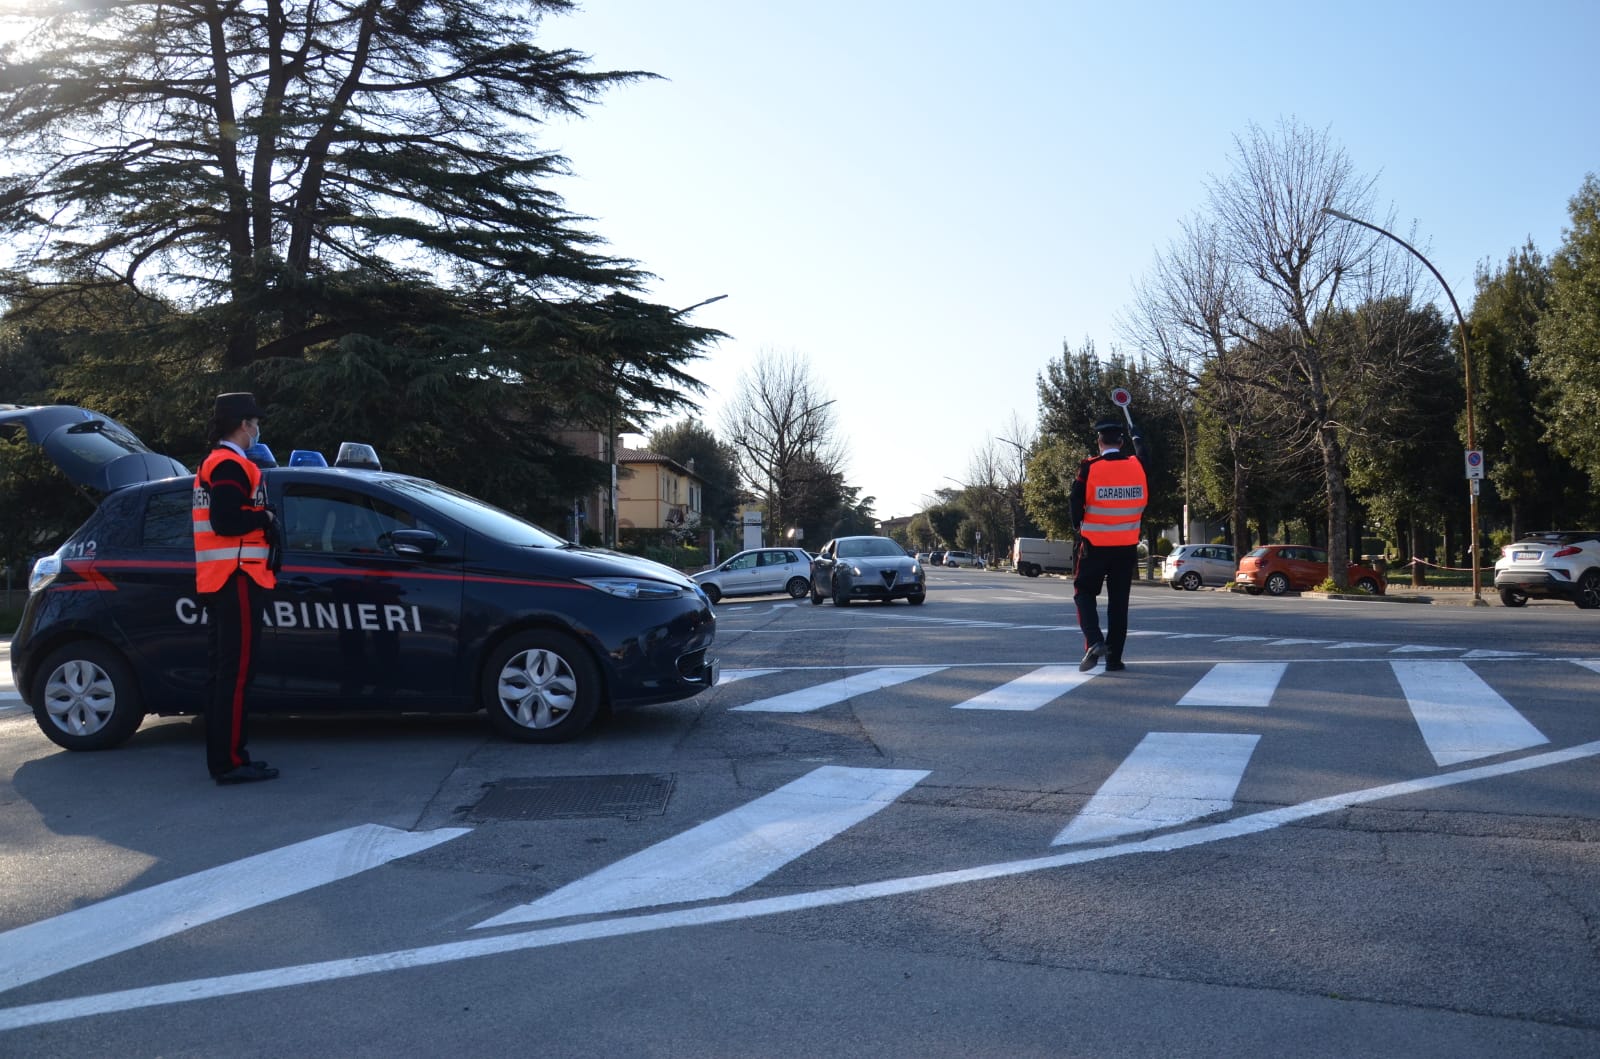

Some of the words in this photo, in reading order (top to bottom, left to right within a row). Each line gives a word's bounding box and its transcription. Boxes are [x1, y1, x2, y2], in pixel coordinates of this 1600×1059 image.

[1098, 486, 1142, 499] CARABINIERI
[70, 540, 97, 557] 112
[175, 597, 422, 633] CBINIERI
